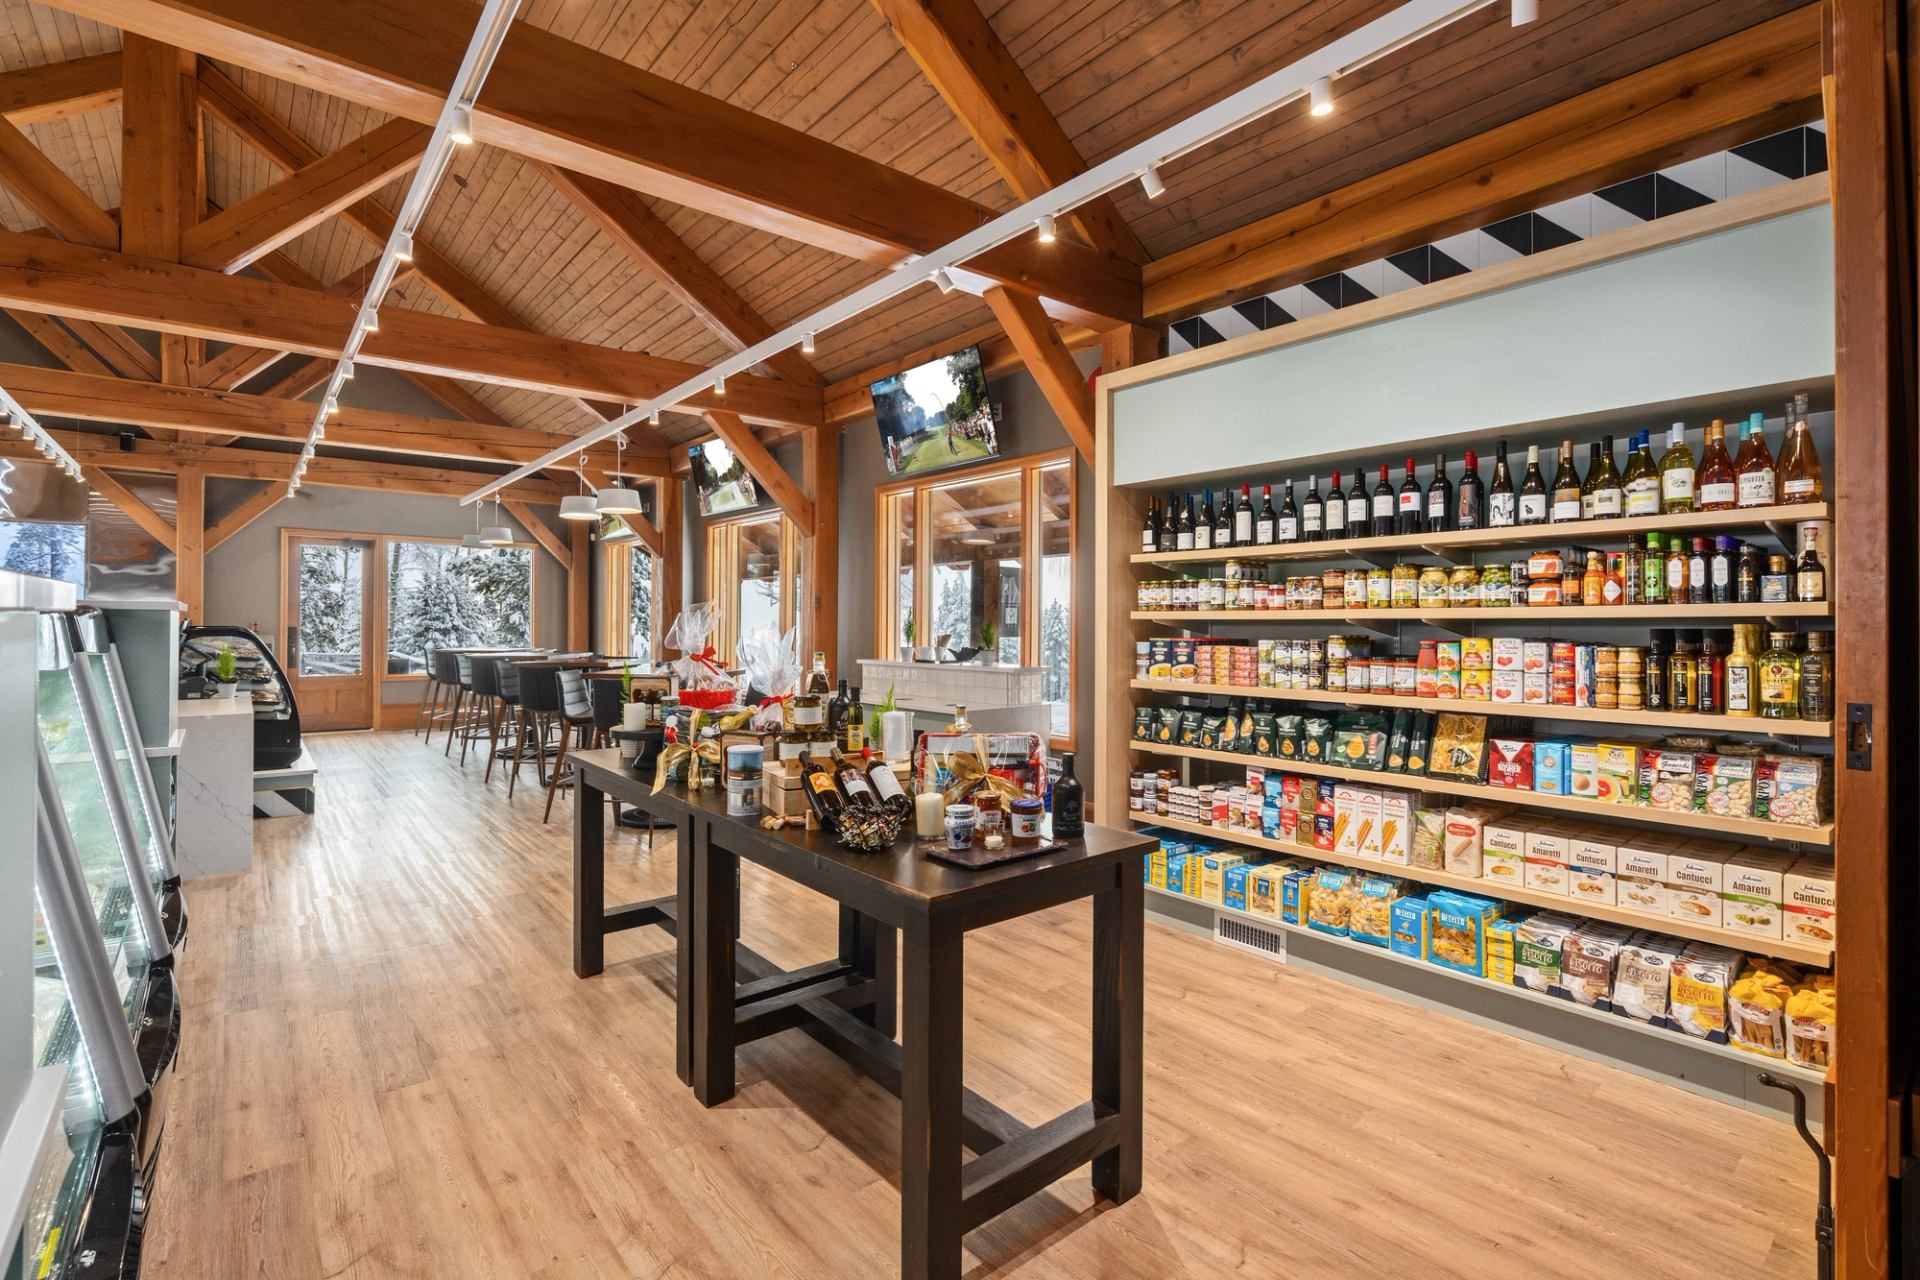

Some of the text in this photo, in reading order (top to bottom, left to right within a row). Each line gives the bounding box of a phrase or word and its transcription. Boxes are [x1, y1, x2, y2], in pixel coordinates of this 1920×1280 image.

[1498, 763, 1521, 773] KOSHER
[1490, 838, 1517, 850] Cantucci
[1532, 846, 1561, 859] Amaretti
[1576, 854, 1607, 866] Cantucci
[1625, 863, 1658, 876] Amaretti
[1676, 871, 1712, 885] Cantucci
[1733, 881, 1771, 896] Amaretti
[1793, 891, 1835, 907] Cantucci
[1448, 914, 1464, 926] CECCO
[1569, 958, 1602, 974] RISOTTO
[1625, 966, 1661, 983] RISOTTO
[1677, 983, 1715, 1002] RISOTTO
